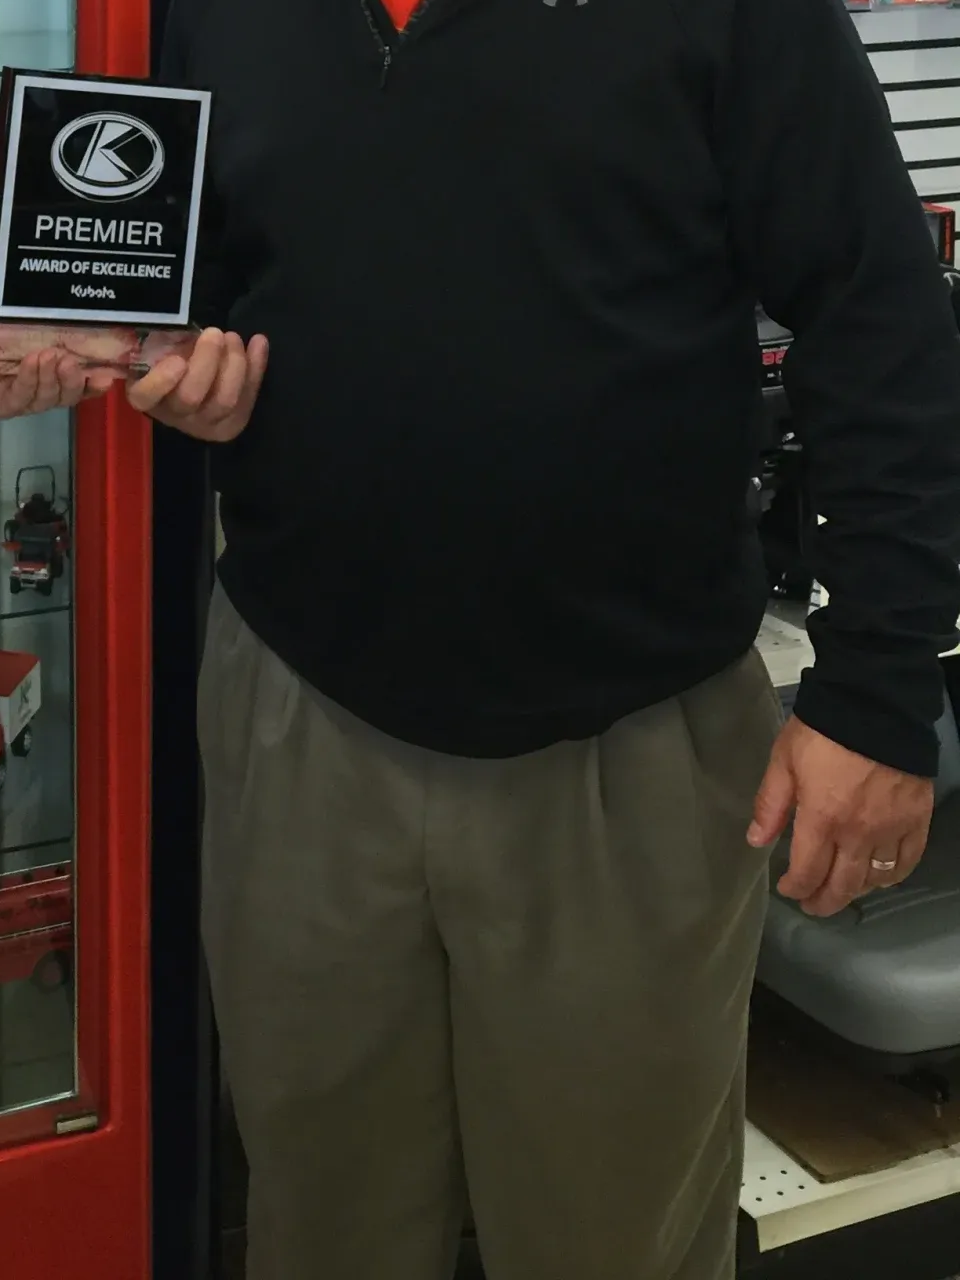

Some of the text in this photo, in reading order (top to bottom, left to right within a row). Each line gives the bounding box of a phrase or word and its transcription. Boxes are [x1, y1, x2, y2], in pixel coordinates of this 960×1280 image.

[35, 215, 163, 246] PREMIER
[19, 257, 171, 279] AWARD OF EXCELLENCE
[70, 284, 116, 300] Kubota
